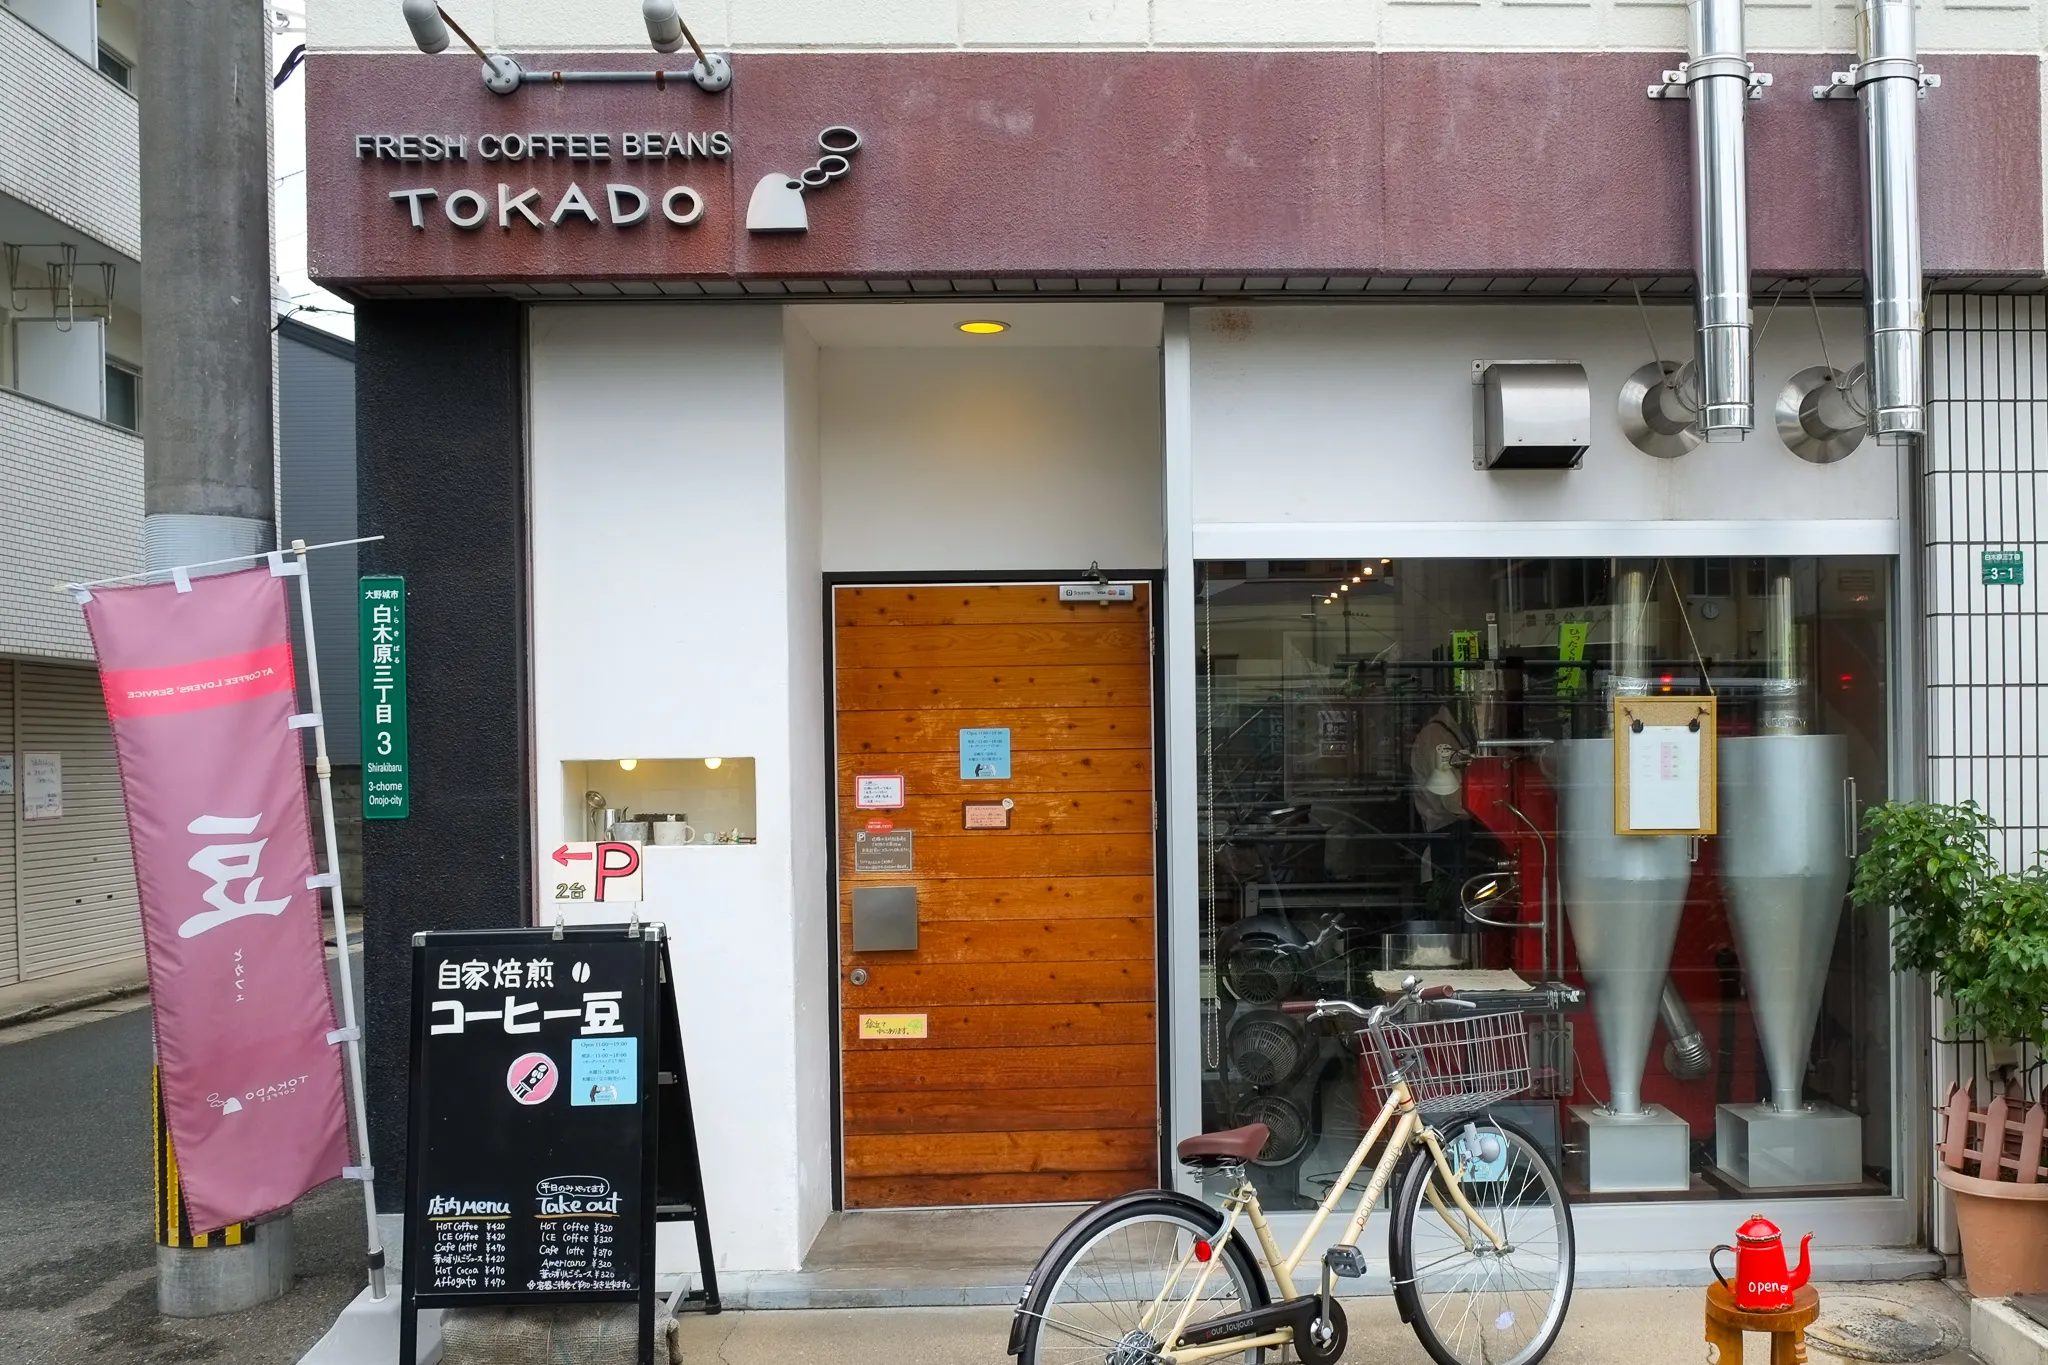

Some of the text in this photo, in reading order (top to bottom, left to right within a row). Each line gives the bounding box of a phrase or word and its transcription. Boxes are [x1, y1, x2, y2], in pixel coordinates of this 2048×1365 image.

[355, 131, 731, 160] FRESH COFFEE BEANS
[389, 181, 704, 230] TOKADO
[1991, 567, 2014, 580] 3-1
[365, 590, 399, 600] 大野城市
[372, 604, 393, 724] 白木原三丁目
[377, 731, 392, 755] 3
[368, 762, 402, 773] Shirakibaru
[368, 781, 402, 792] 3-chome
[369, 795, 403, 807] Onojo-city
[594, 842, 640, 902] P
[555, 882, 586, 899] 2台
[438, 957, 554, 991] 自家焙煎
[431, 991, 625, 1036] コーヒー豆
[535, 1191, 623, 1215] Take out
[454, 1222, 479, 1231] Coffee
[563, 1222, 589, 1232] Coffee
[438, 1233, 453, 1241] ICE
[455, 1232, 479, 1242] Coffee
[541, 1232, 556, 1242] ICE
[563, 1232, 589, 1243] Coffee
[434, 1243, 456, 1252] Cafe
[539, 1245, 559, 1256] Cafe
[541, 1259, 586, 1268] Americano
[434, 1275, 477, 1288] Affogato
